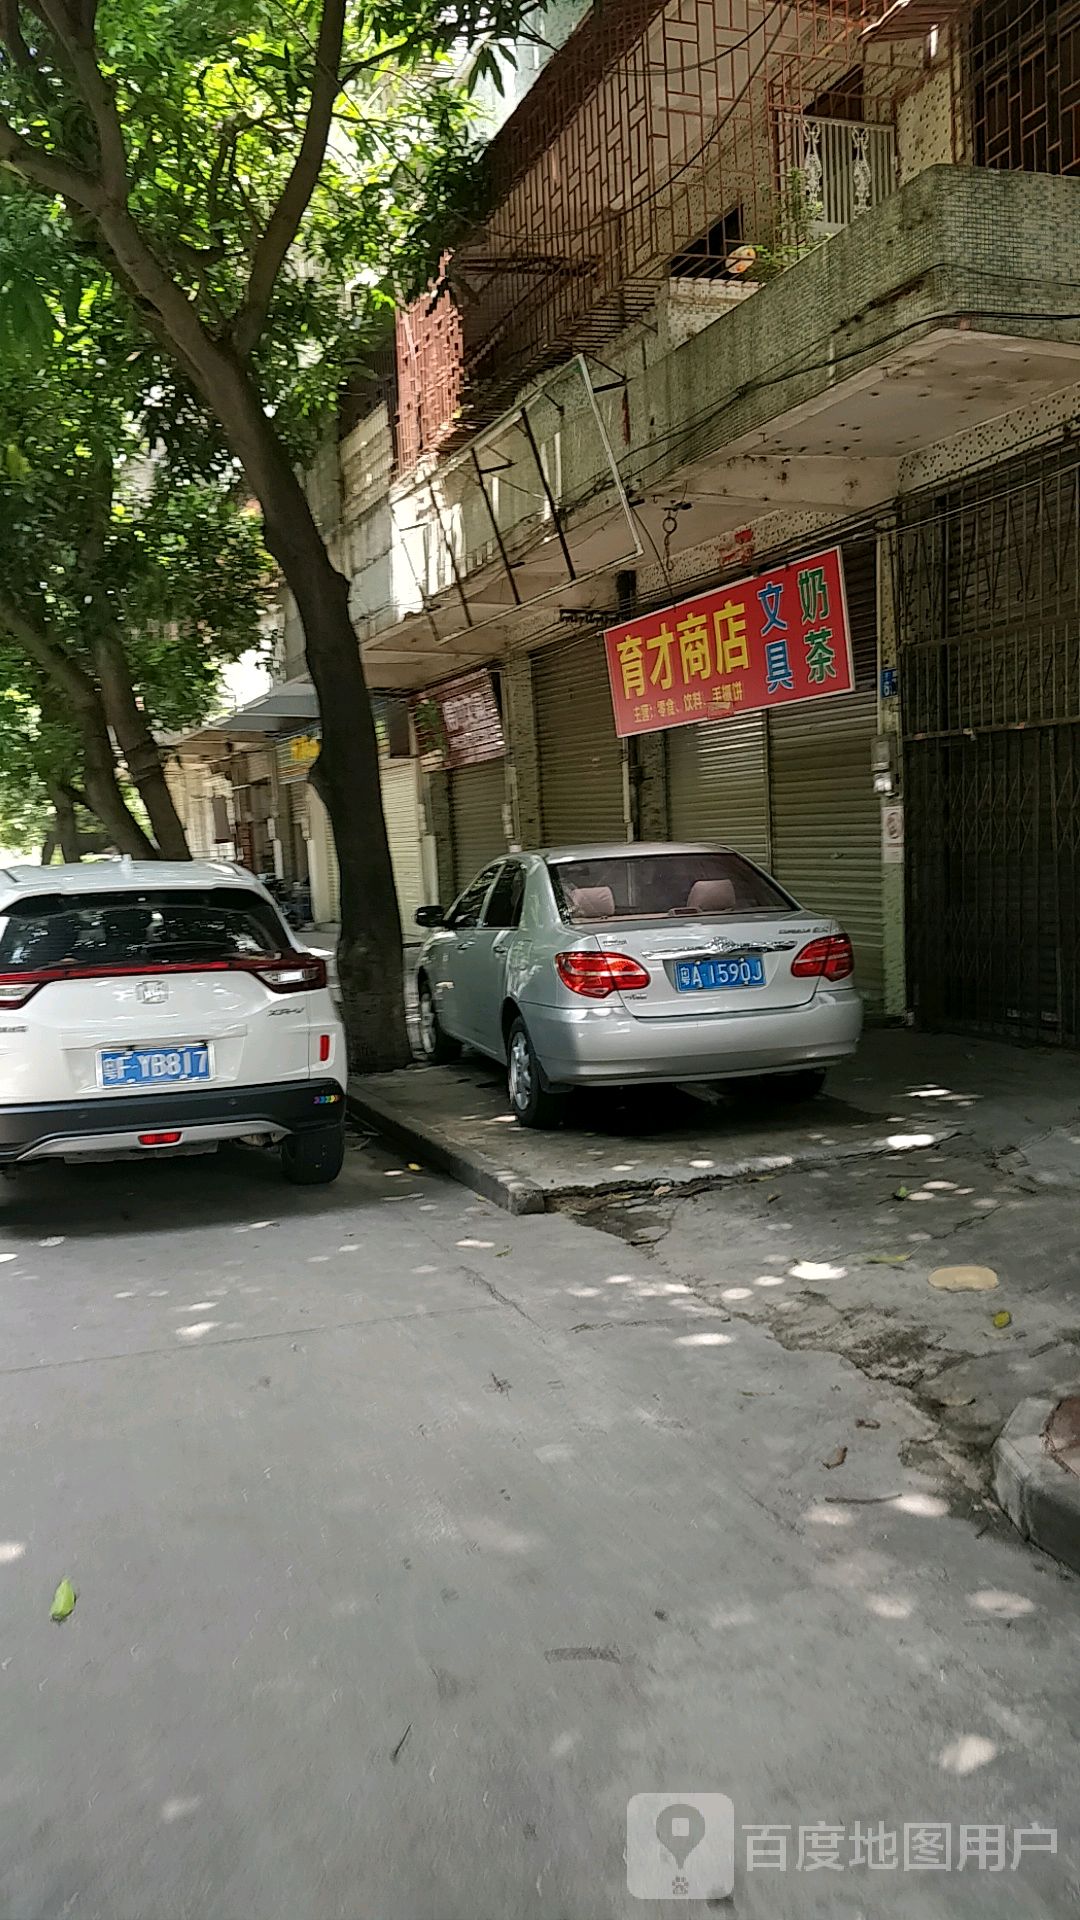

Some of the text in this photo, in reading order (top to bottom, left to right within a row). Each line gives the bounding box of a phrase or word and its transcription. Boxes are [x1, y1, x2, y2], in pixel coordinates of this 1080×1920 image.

[616, 600, 751, 700] 育才商店
[757, 581, 794, 695] 文具
[797, 566, 837, 684] 奶茶
